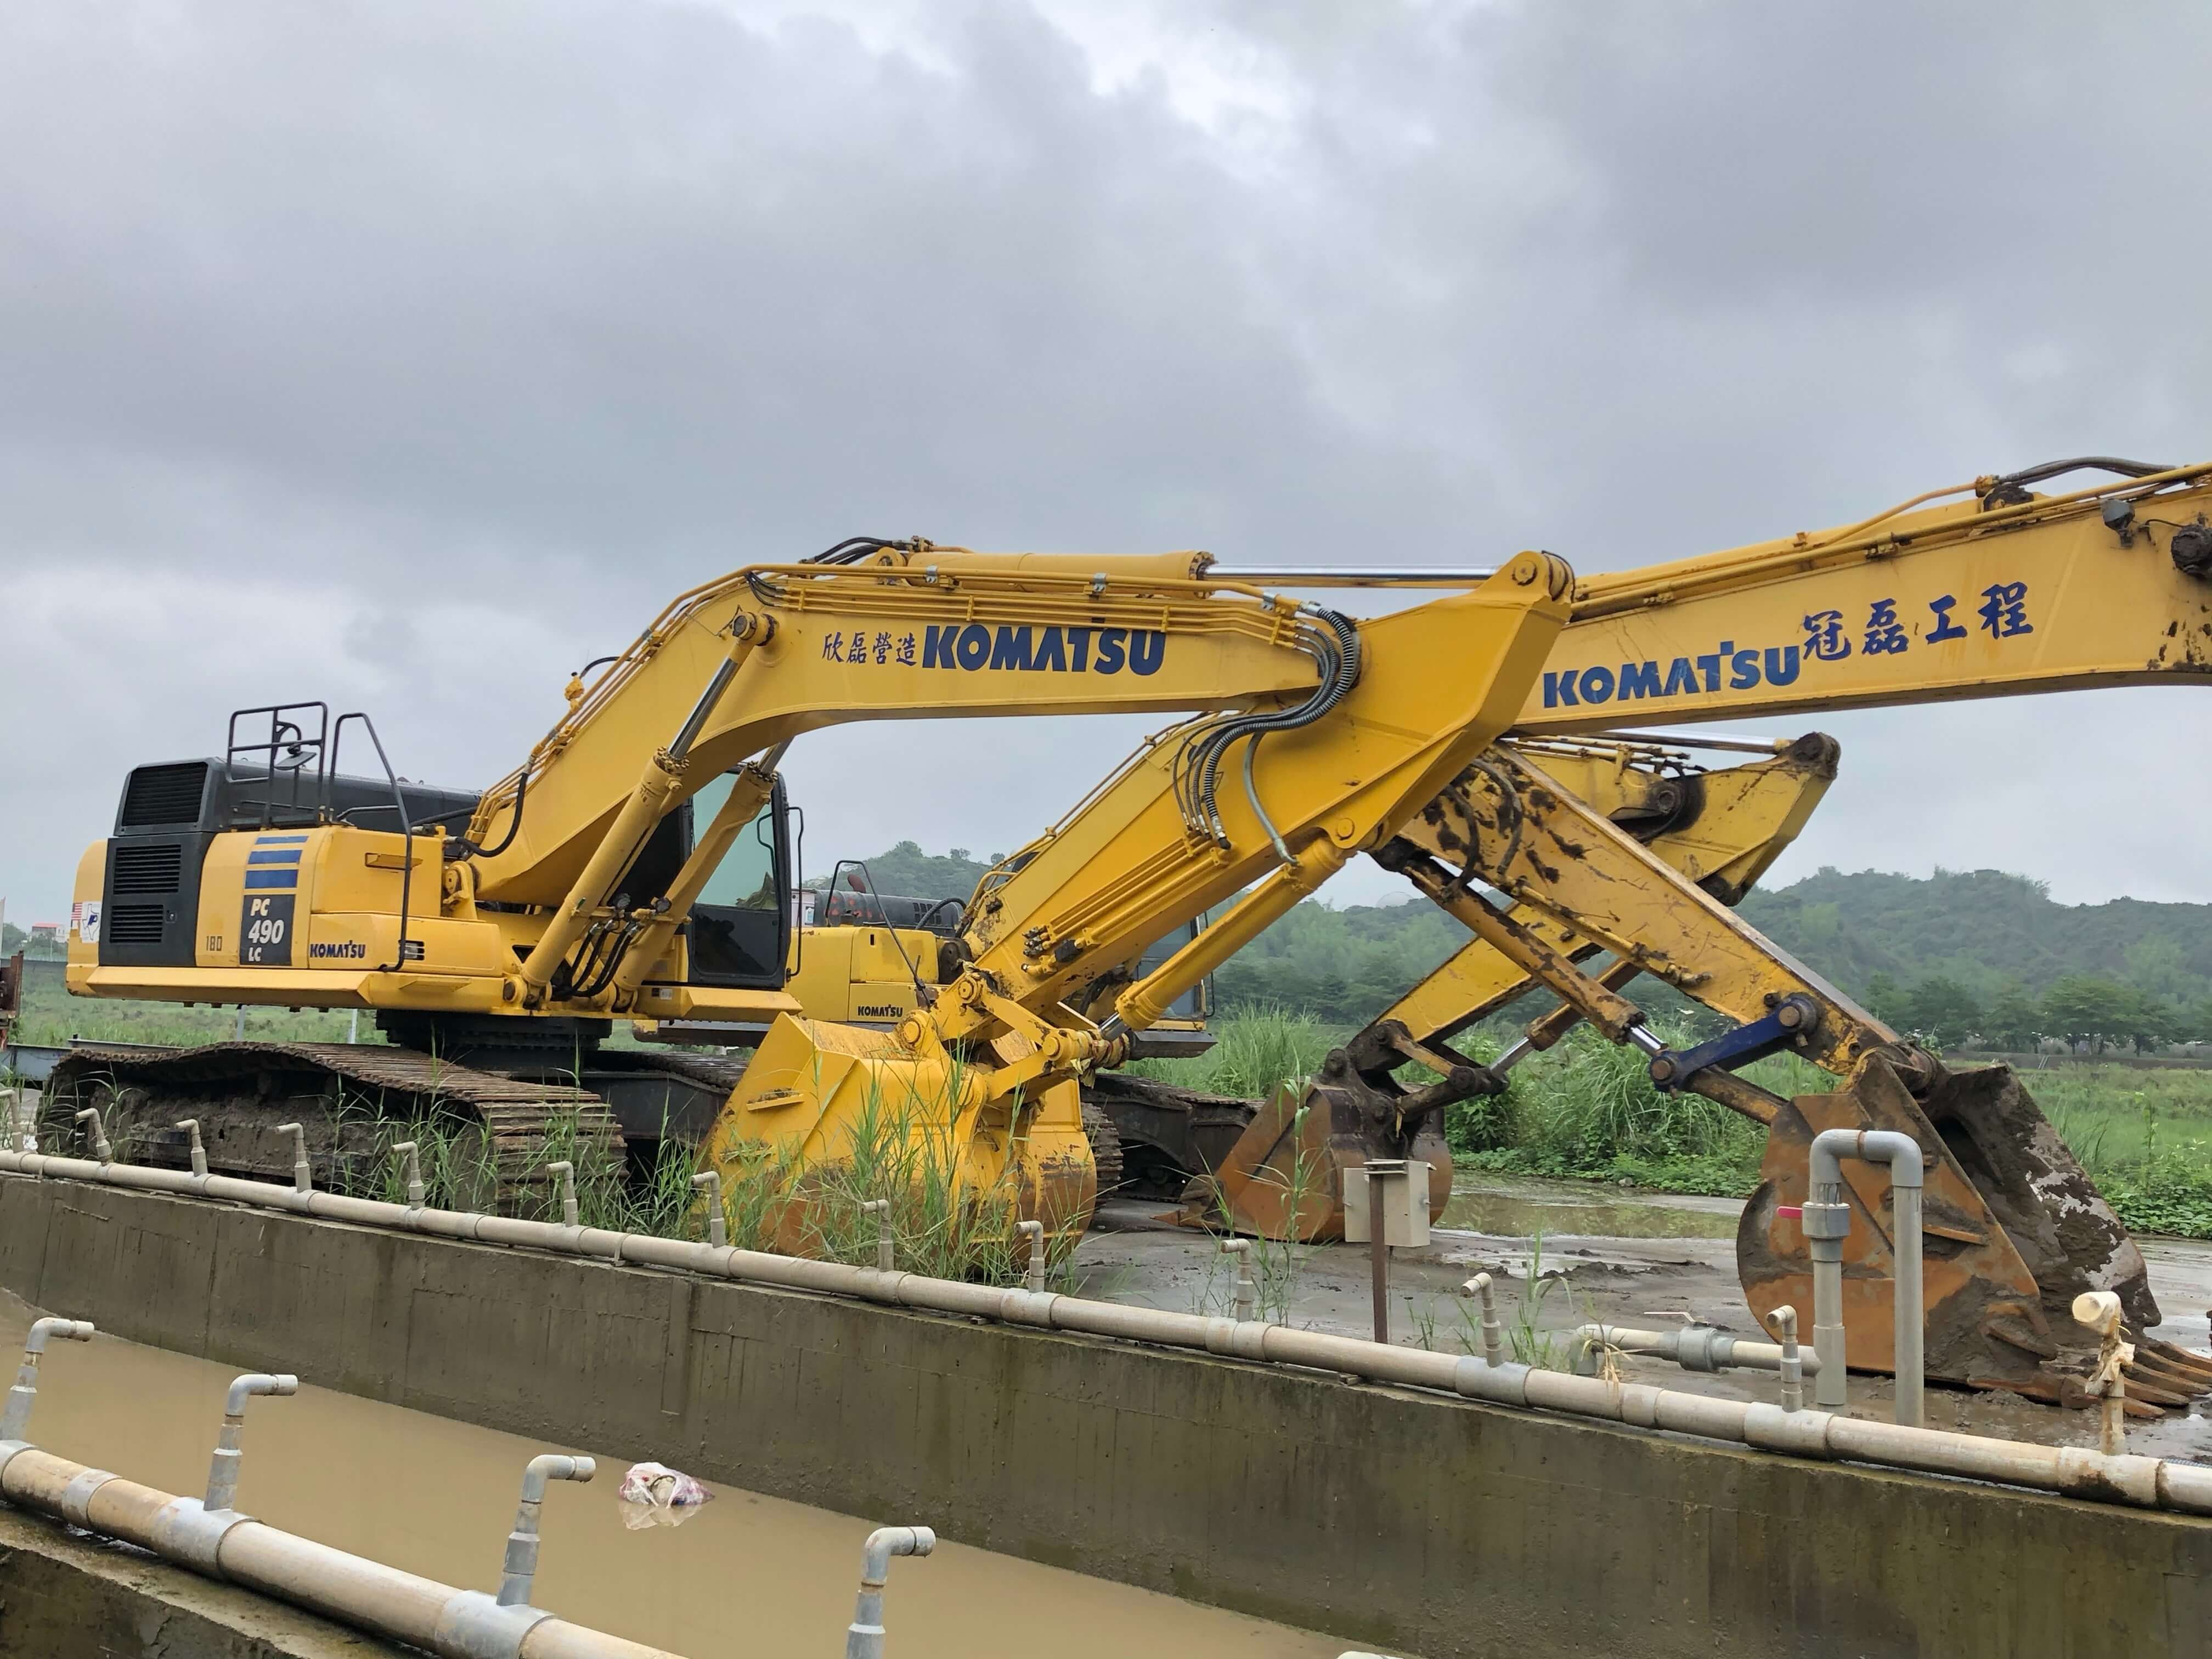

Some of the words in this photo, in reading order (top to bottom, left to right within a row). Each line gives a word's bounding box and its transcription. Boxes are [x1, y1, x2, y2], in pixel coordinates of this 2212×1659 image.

[822, 631, 917, 666] 欣磊營造
[922, 618, 1166, 676] KOMATSU
[1543, 640, 1801, 708] KOMATSU
[1802, 582, 2034, 661] 冠磊工程
[250, 898, 271, 917] PC
[248, 919, 284, 944] 490
[248, 947, 262, 962] LC
[310, 940, 366, 958] KOMATSU
[857, 1004, 903, 1017] KOMATSU
